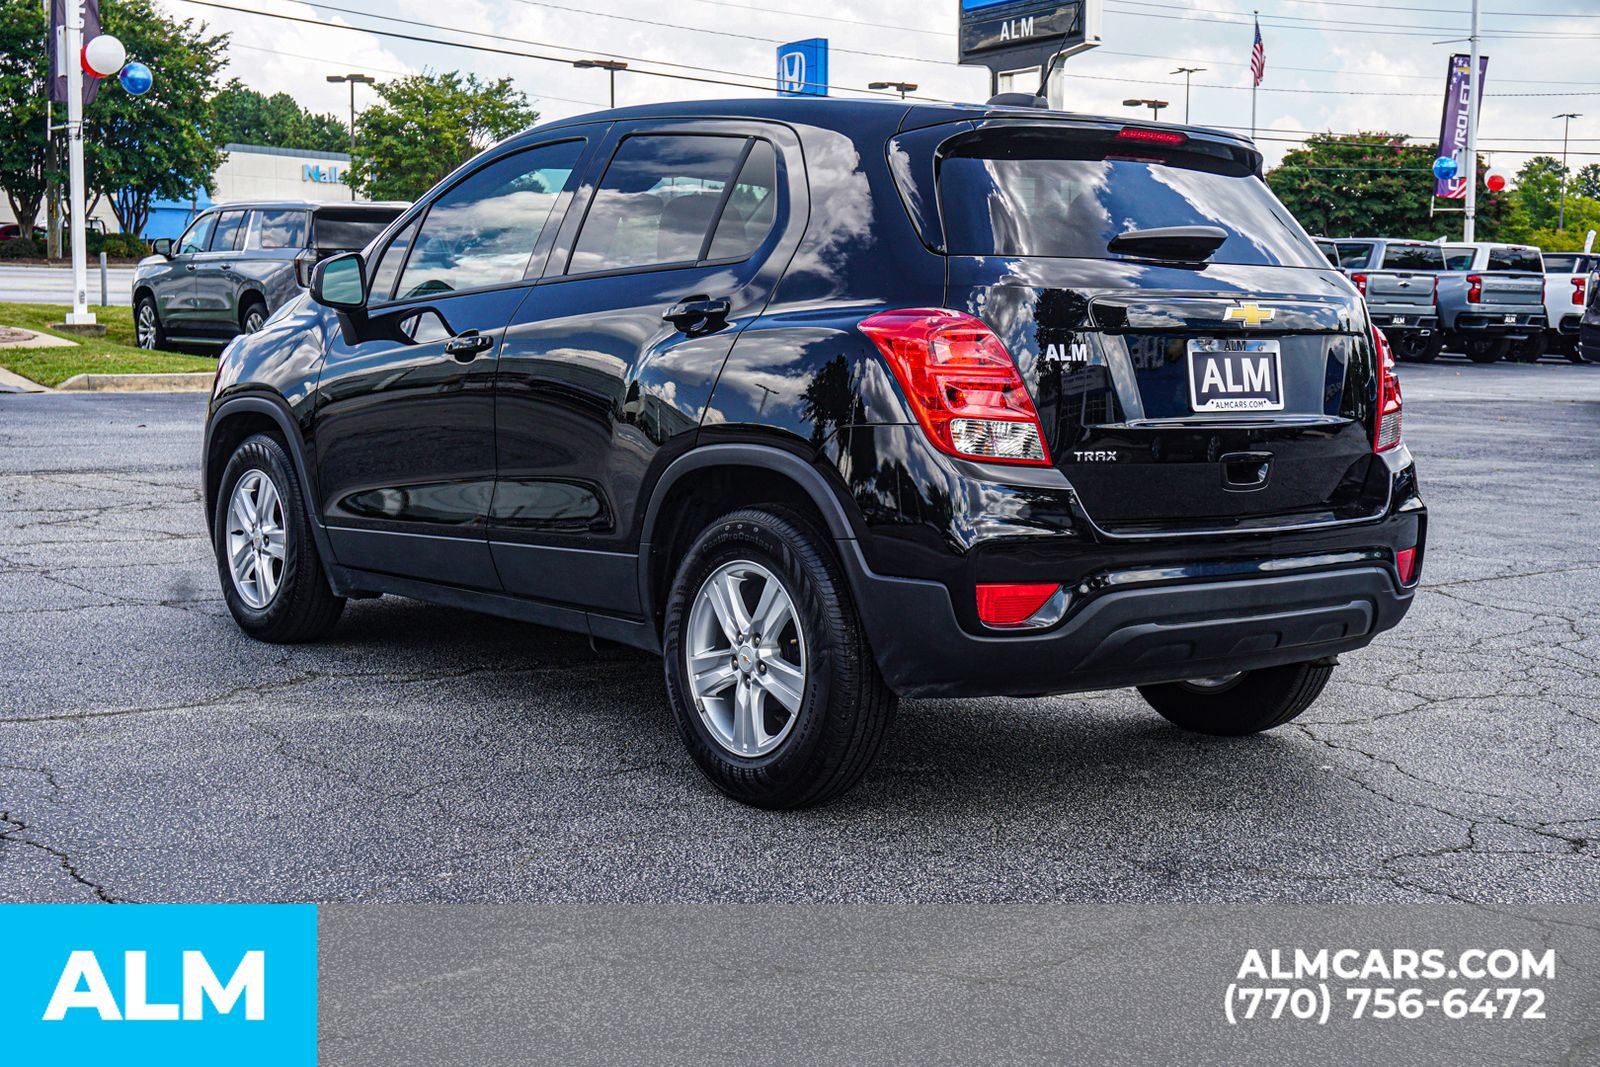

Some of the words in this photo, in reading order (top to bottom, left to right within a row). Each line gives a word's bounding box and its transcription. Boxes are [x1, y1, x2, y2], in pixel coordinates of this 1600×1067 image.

[1000, 16, 1034, 41] ALM
[1045, 343, 1088, 362] ALM
[1224, 340, 1247, 352] ALM
[1201, 357, 1271, 393] ALM
[1215, 400, 1264, 409] ALMCARS.COM
[1073, 451, 1117, 462] TRAX
